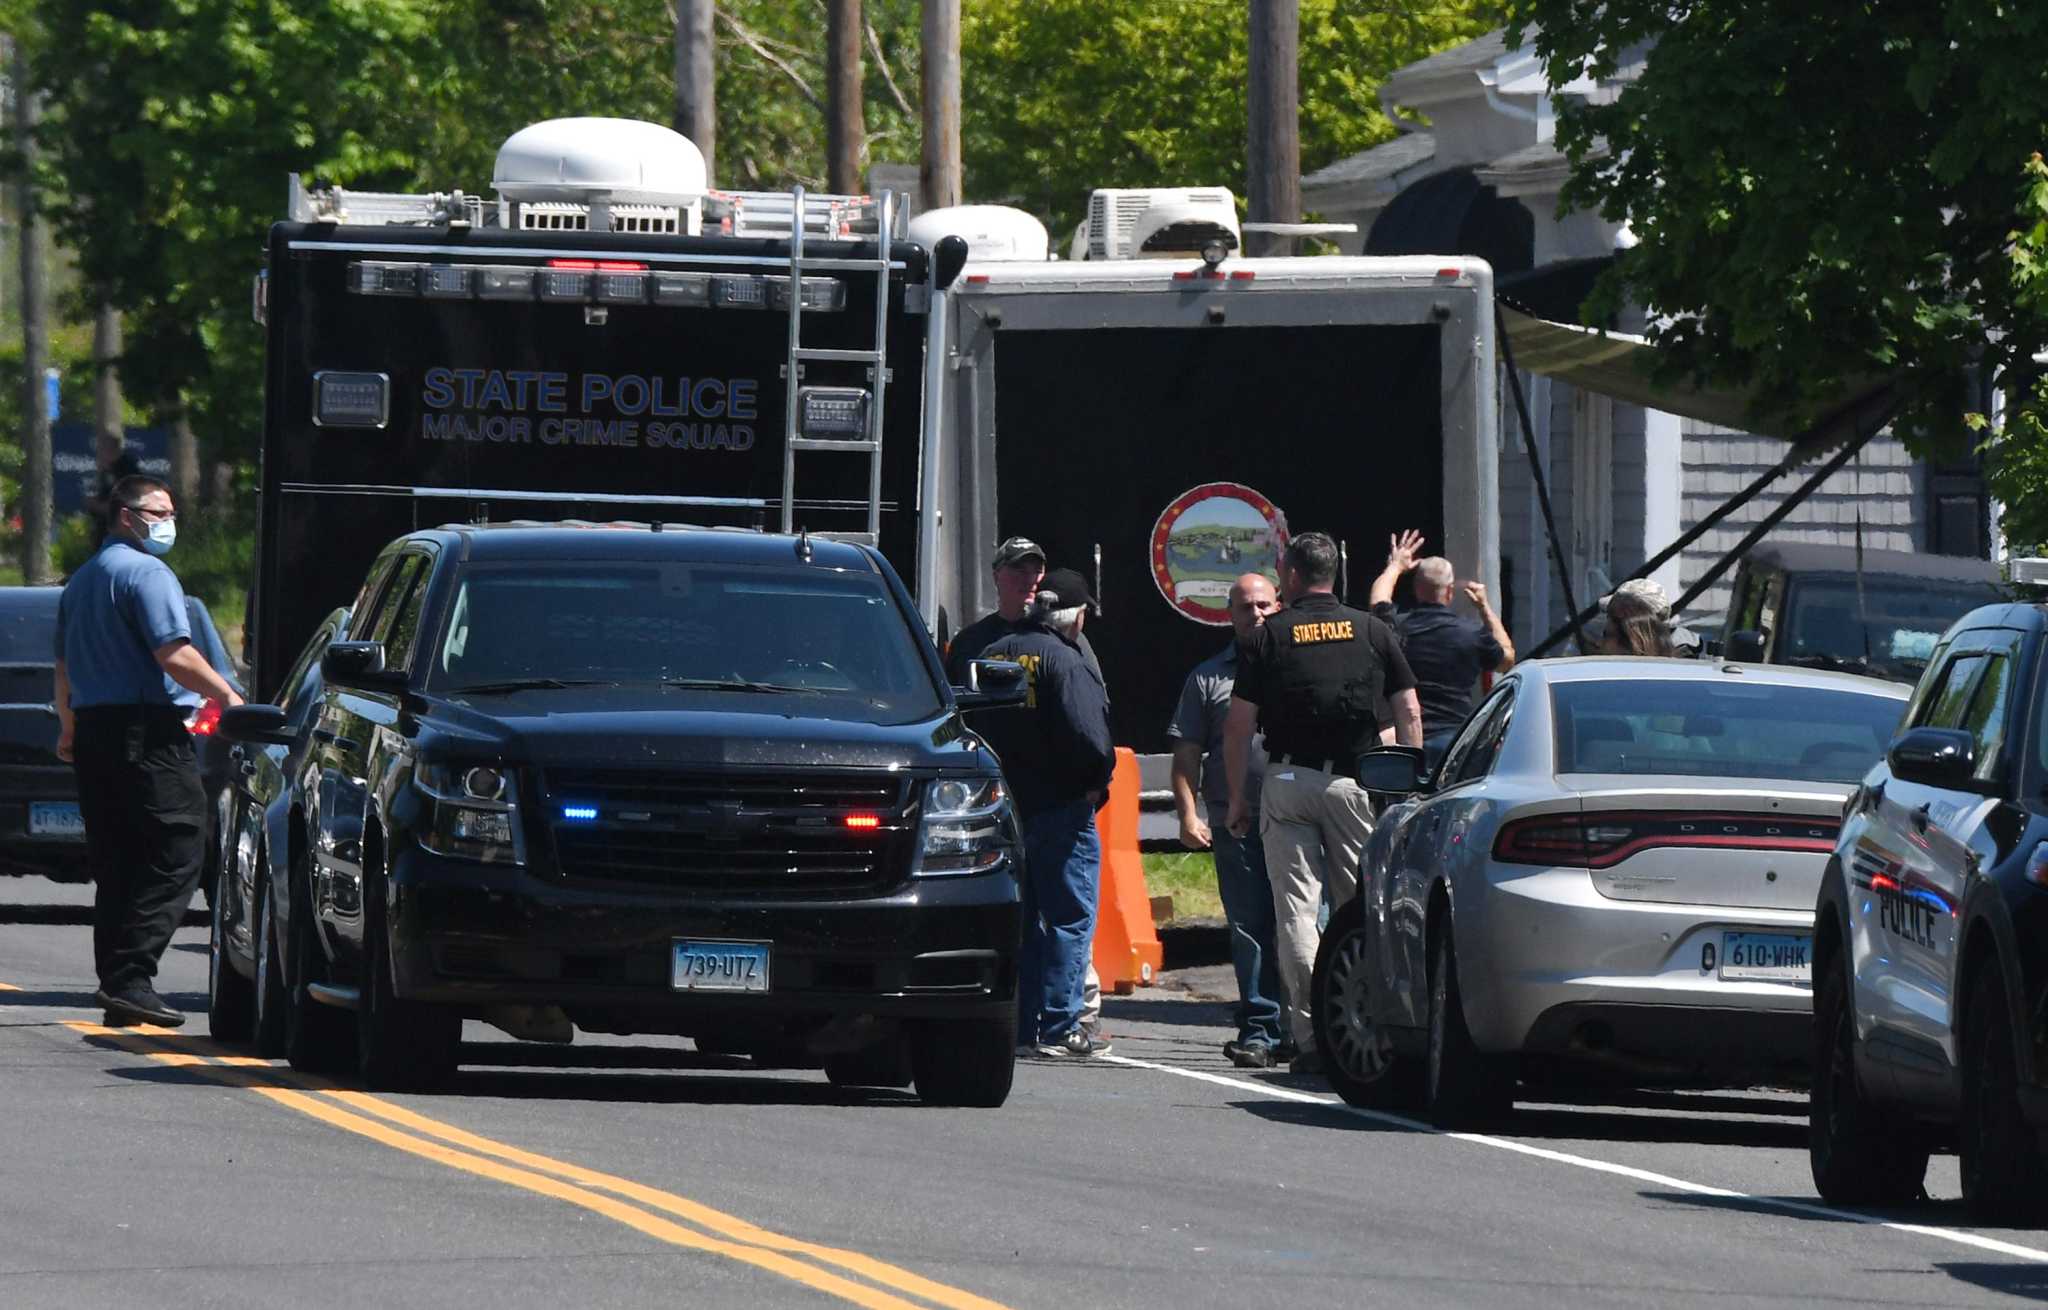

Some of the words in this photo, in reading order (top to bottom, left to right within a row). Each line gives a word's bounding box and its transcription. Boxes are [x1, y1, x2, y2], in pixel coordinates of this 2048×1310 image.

[423, 367, 568, 412] STATE
[581, 373, 759, 420] POLICE
[422, 413, 533, 443] MAJOR
[539, 418, 639, 447] CRIME
[645, 422, 755, 451] SQUAD
[1293, 623, 1320, 643] STATE
[1320, 620, 1354, 640] POLICE
[1680, 824, 1823, 837] DODG
[1880, 892, 1936, 949] POLICE
